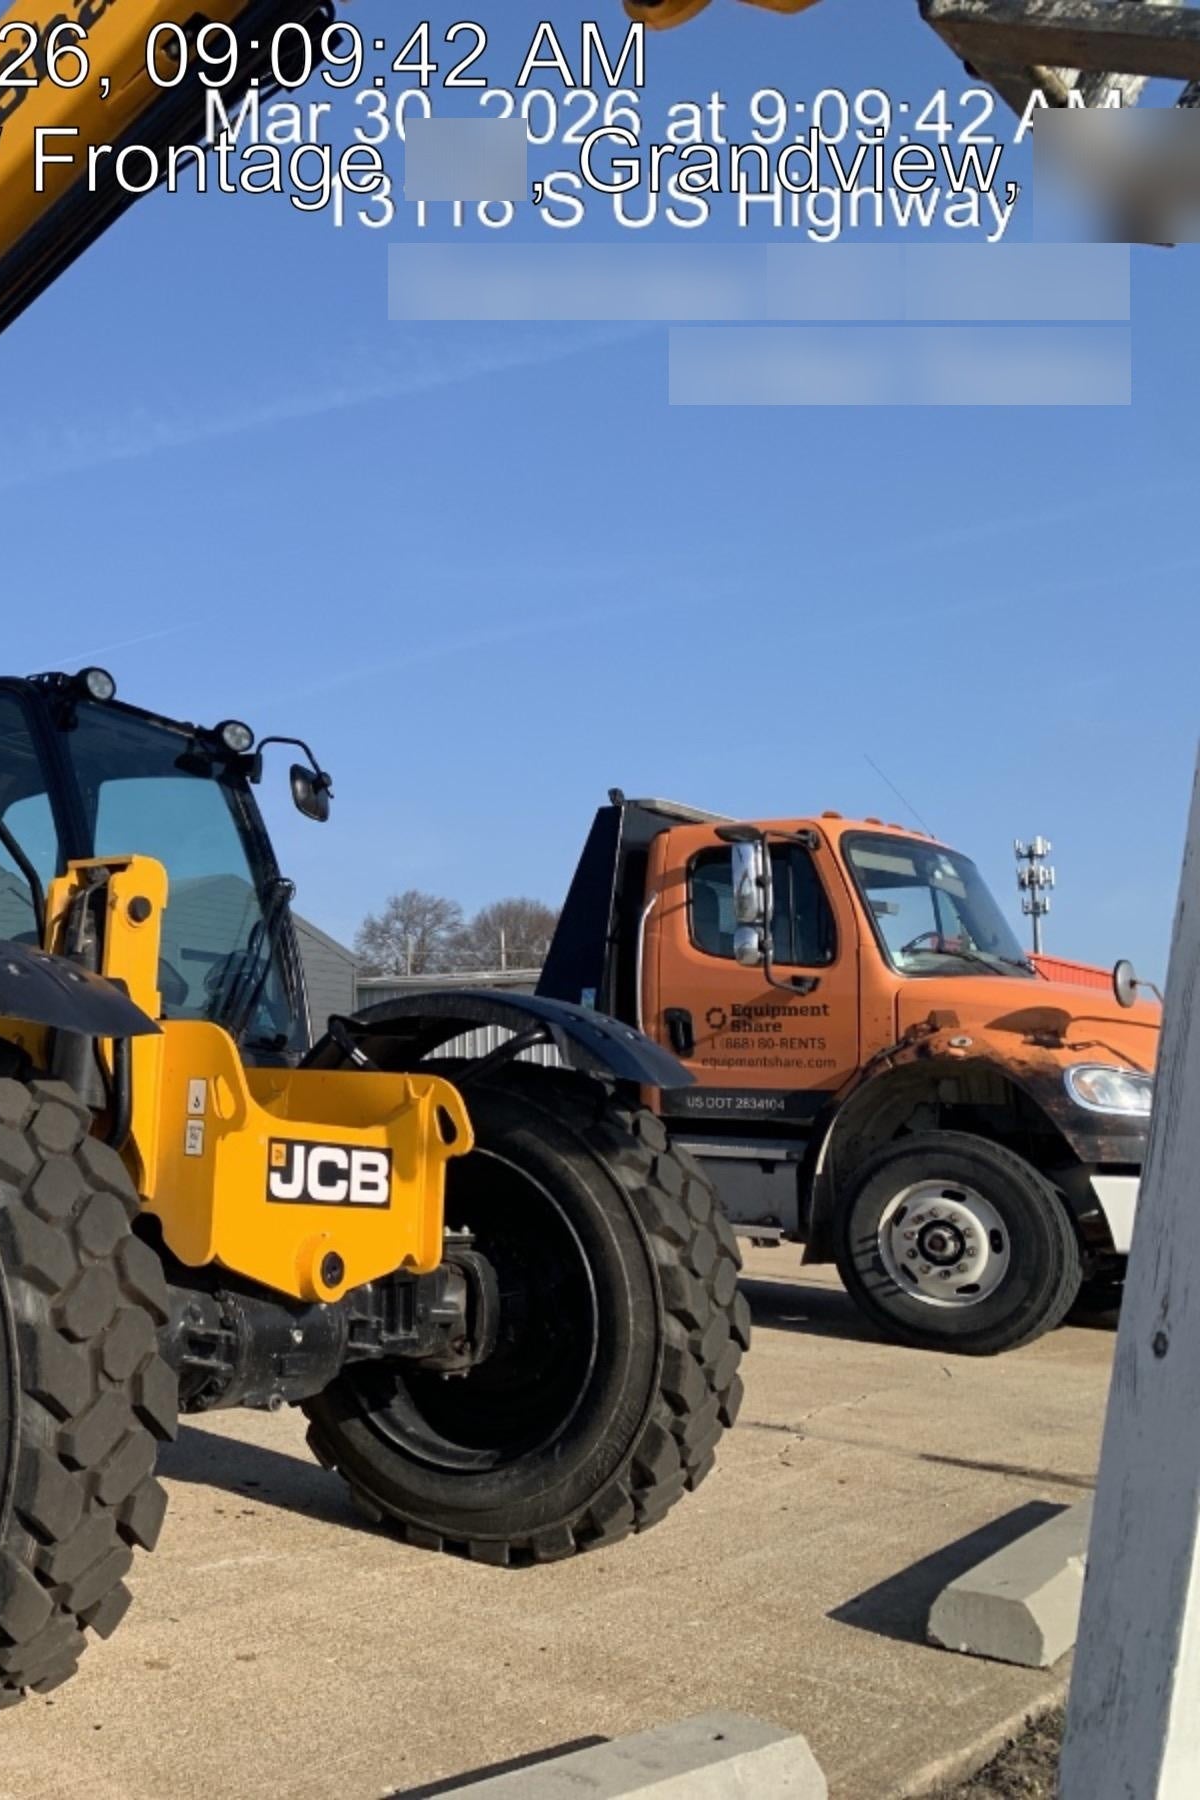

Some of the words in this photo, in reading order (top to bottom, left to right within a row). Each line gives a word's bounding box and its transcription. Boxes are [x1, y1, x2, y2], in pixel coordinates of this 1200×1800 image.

[731, 1004, 830, 1019] Equipment
[731, 1020, 782, 1032] Share
[702, 1055, 837, 1069] equipmentshare.com
[269, 1144, 390, 1204] JCB
